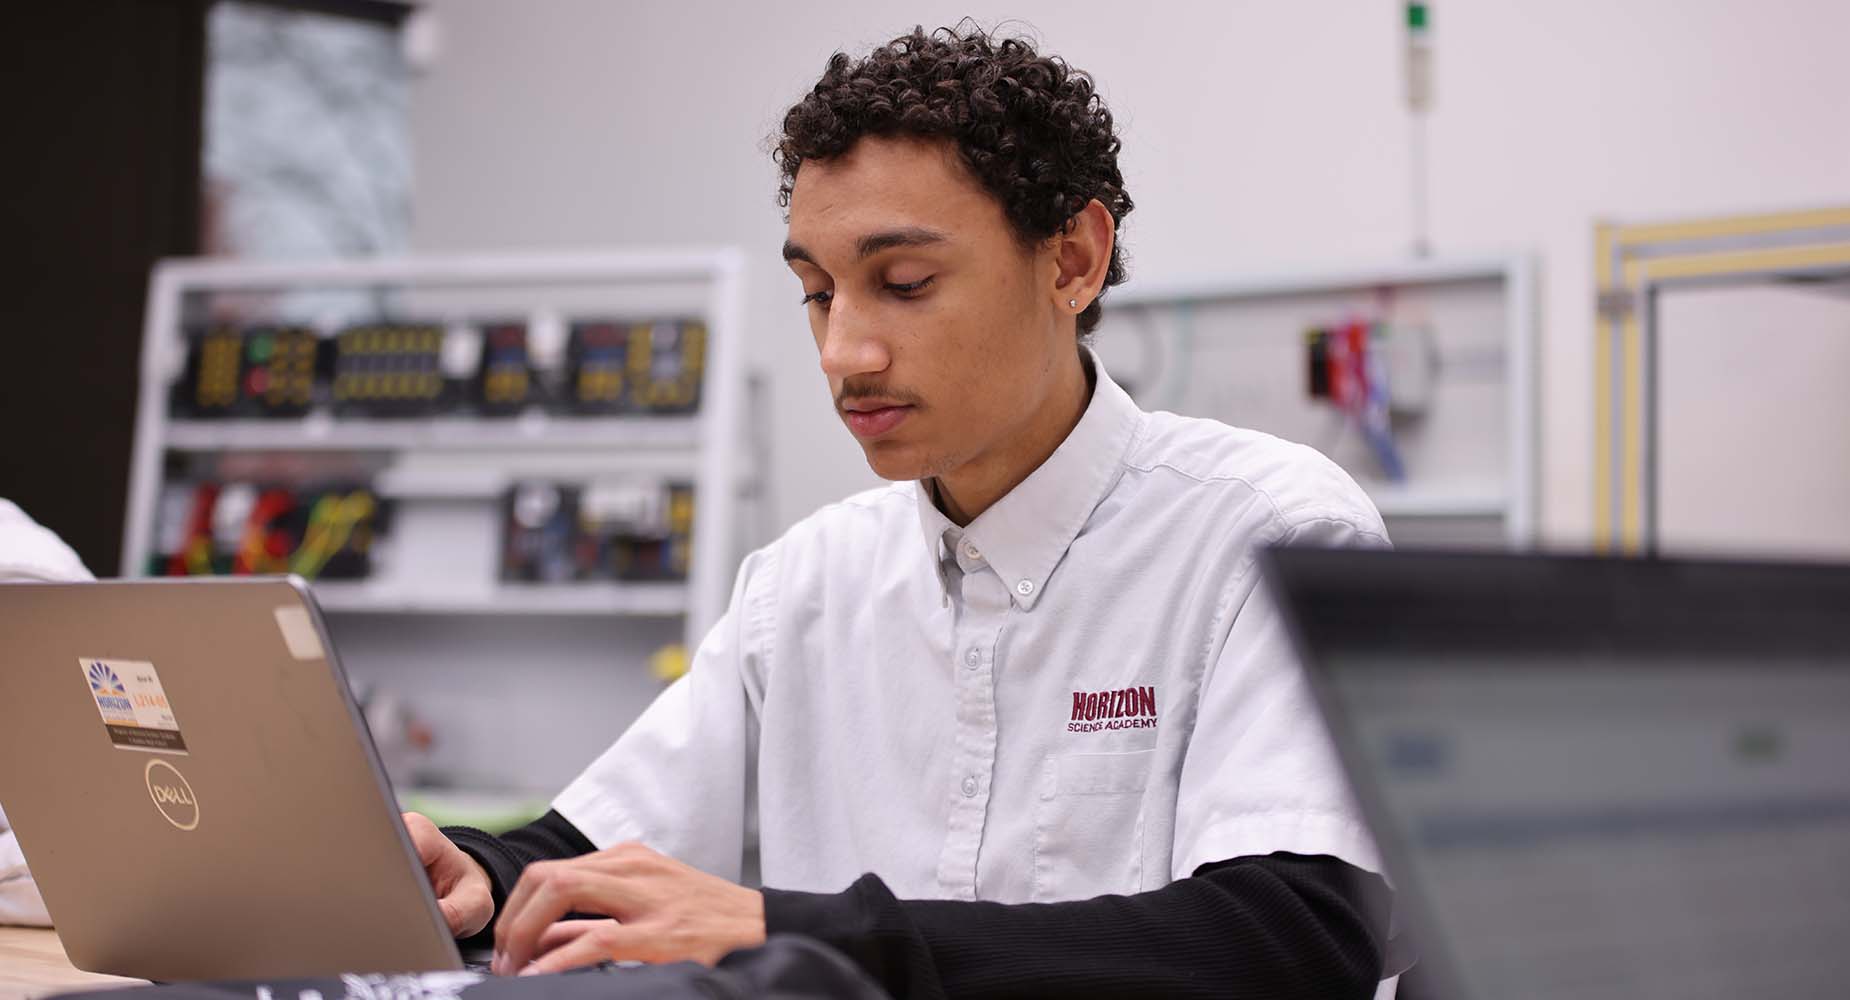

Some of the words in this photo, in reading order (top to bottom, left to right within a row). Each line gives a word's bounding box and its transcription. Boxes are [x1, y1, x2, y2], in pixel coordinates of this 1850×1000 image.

[97, 695, 133, 711] HORIZON
[1071, 686, 1157, 721] HORIZON
[1067, 721, 1103, 732] SCIENCE
[1104, 718, 1158, 730] ACADEMY
[153, 785, 192, 805] DELL
